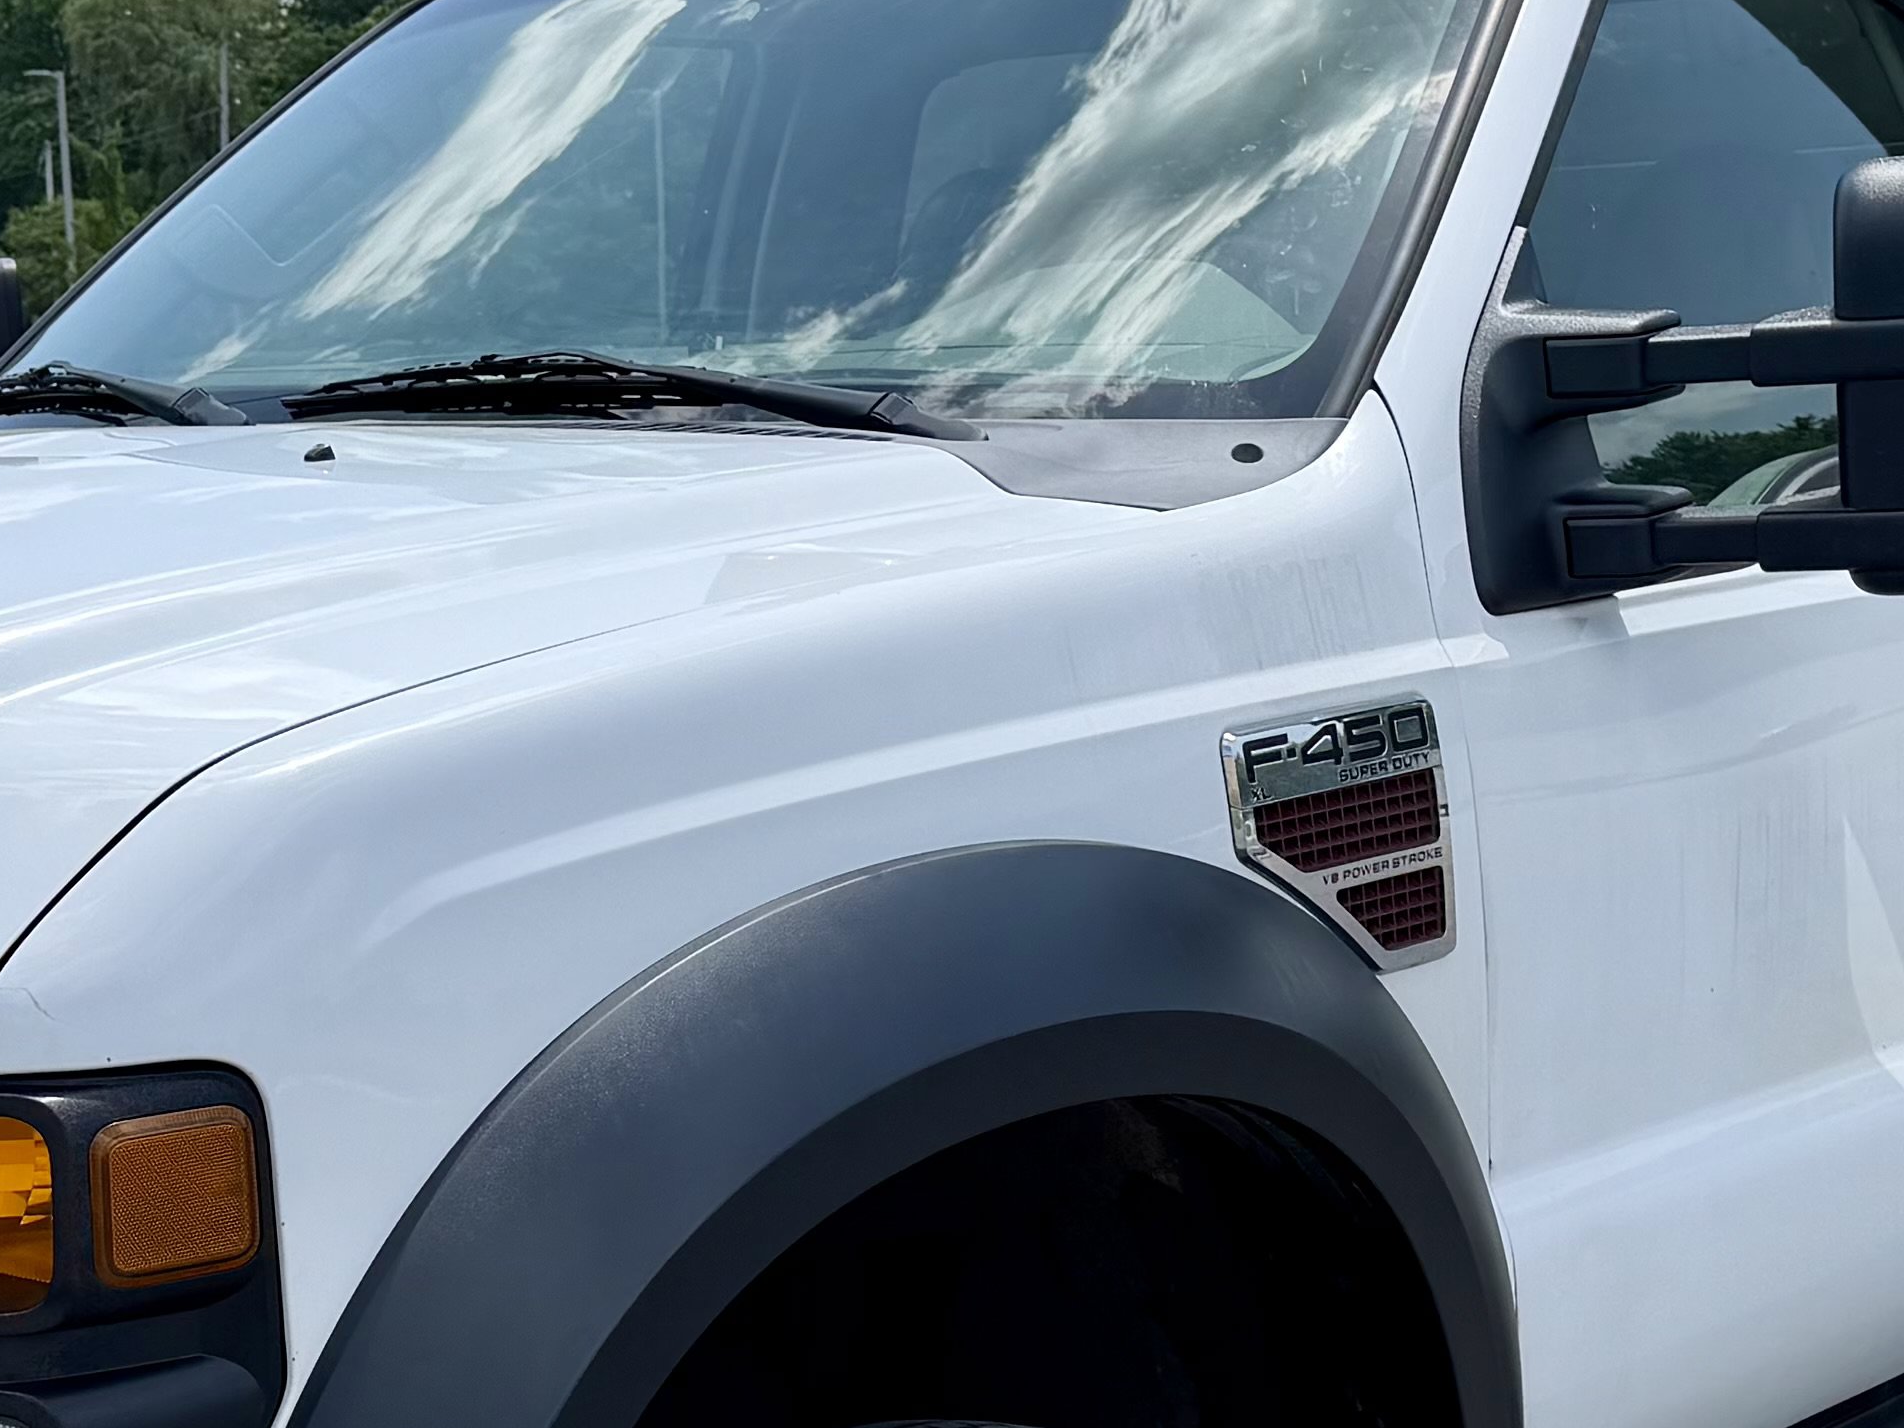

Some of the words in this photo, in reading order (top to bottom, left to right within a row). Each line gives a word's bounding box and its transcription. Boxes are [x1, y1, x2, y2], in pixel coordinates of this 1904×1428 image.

[1243, 708, 1429, 783] F-450
[1339, 761, 1388, 782] SUPER
[1393, 752, 1430, 769] DUTY
[1250, 787, 1271, 801] XL
[1322, 873, 1338, 885] V8
